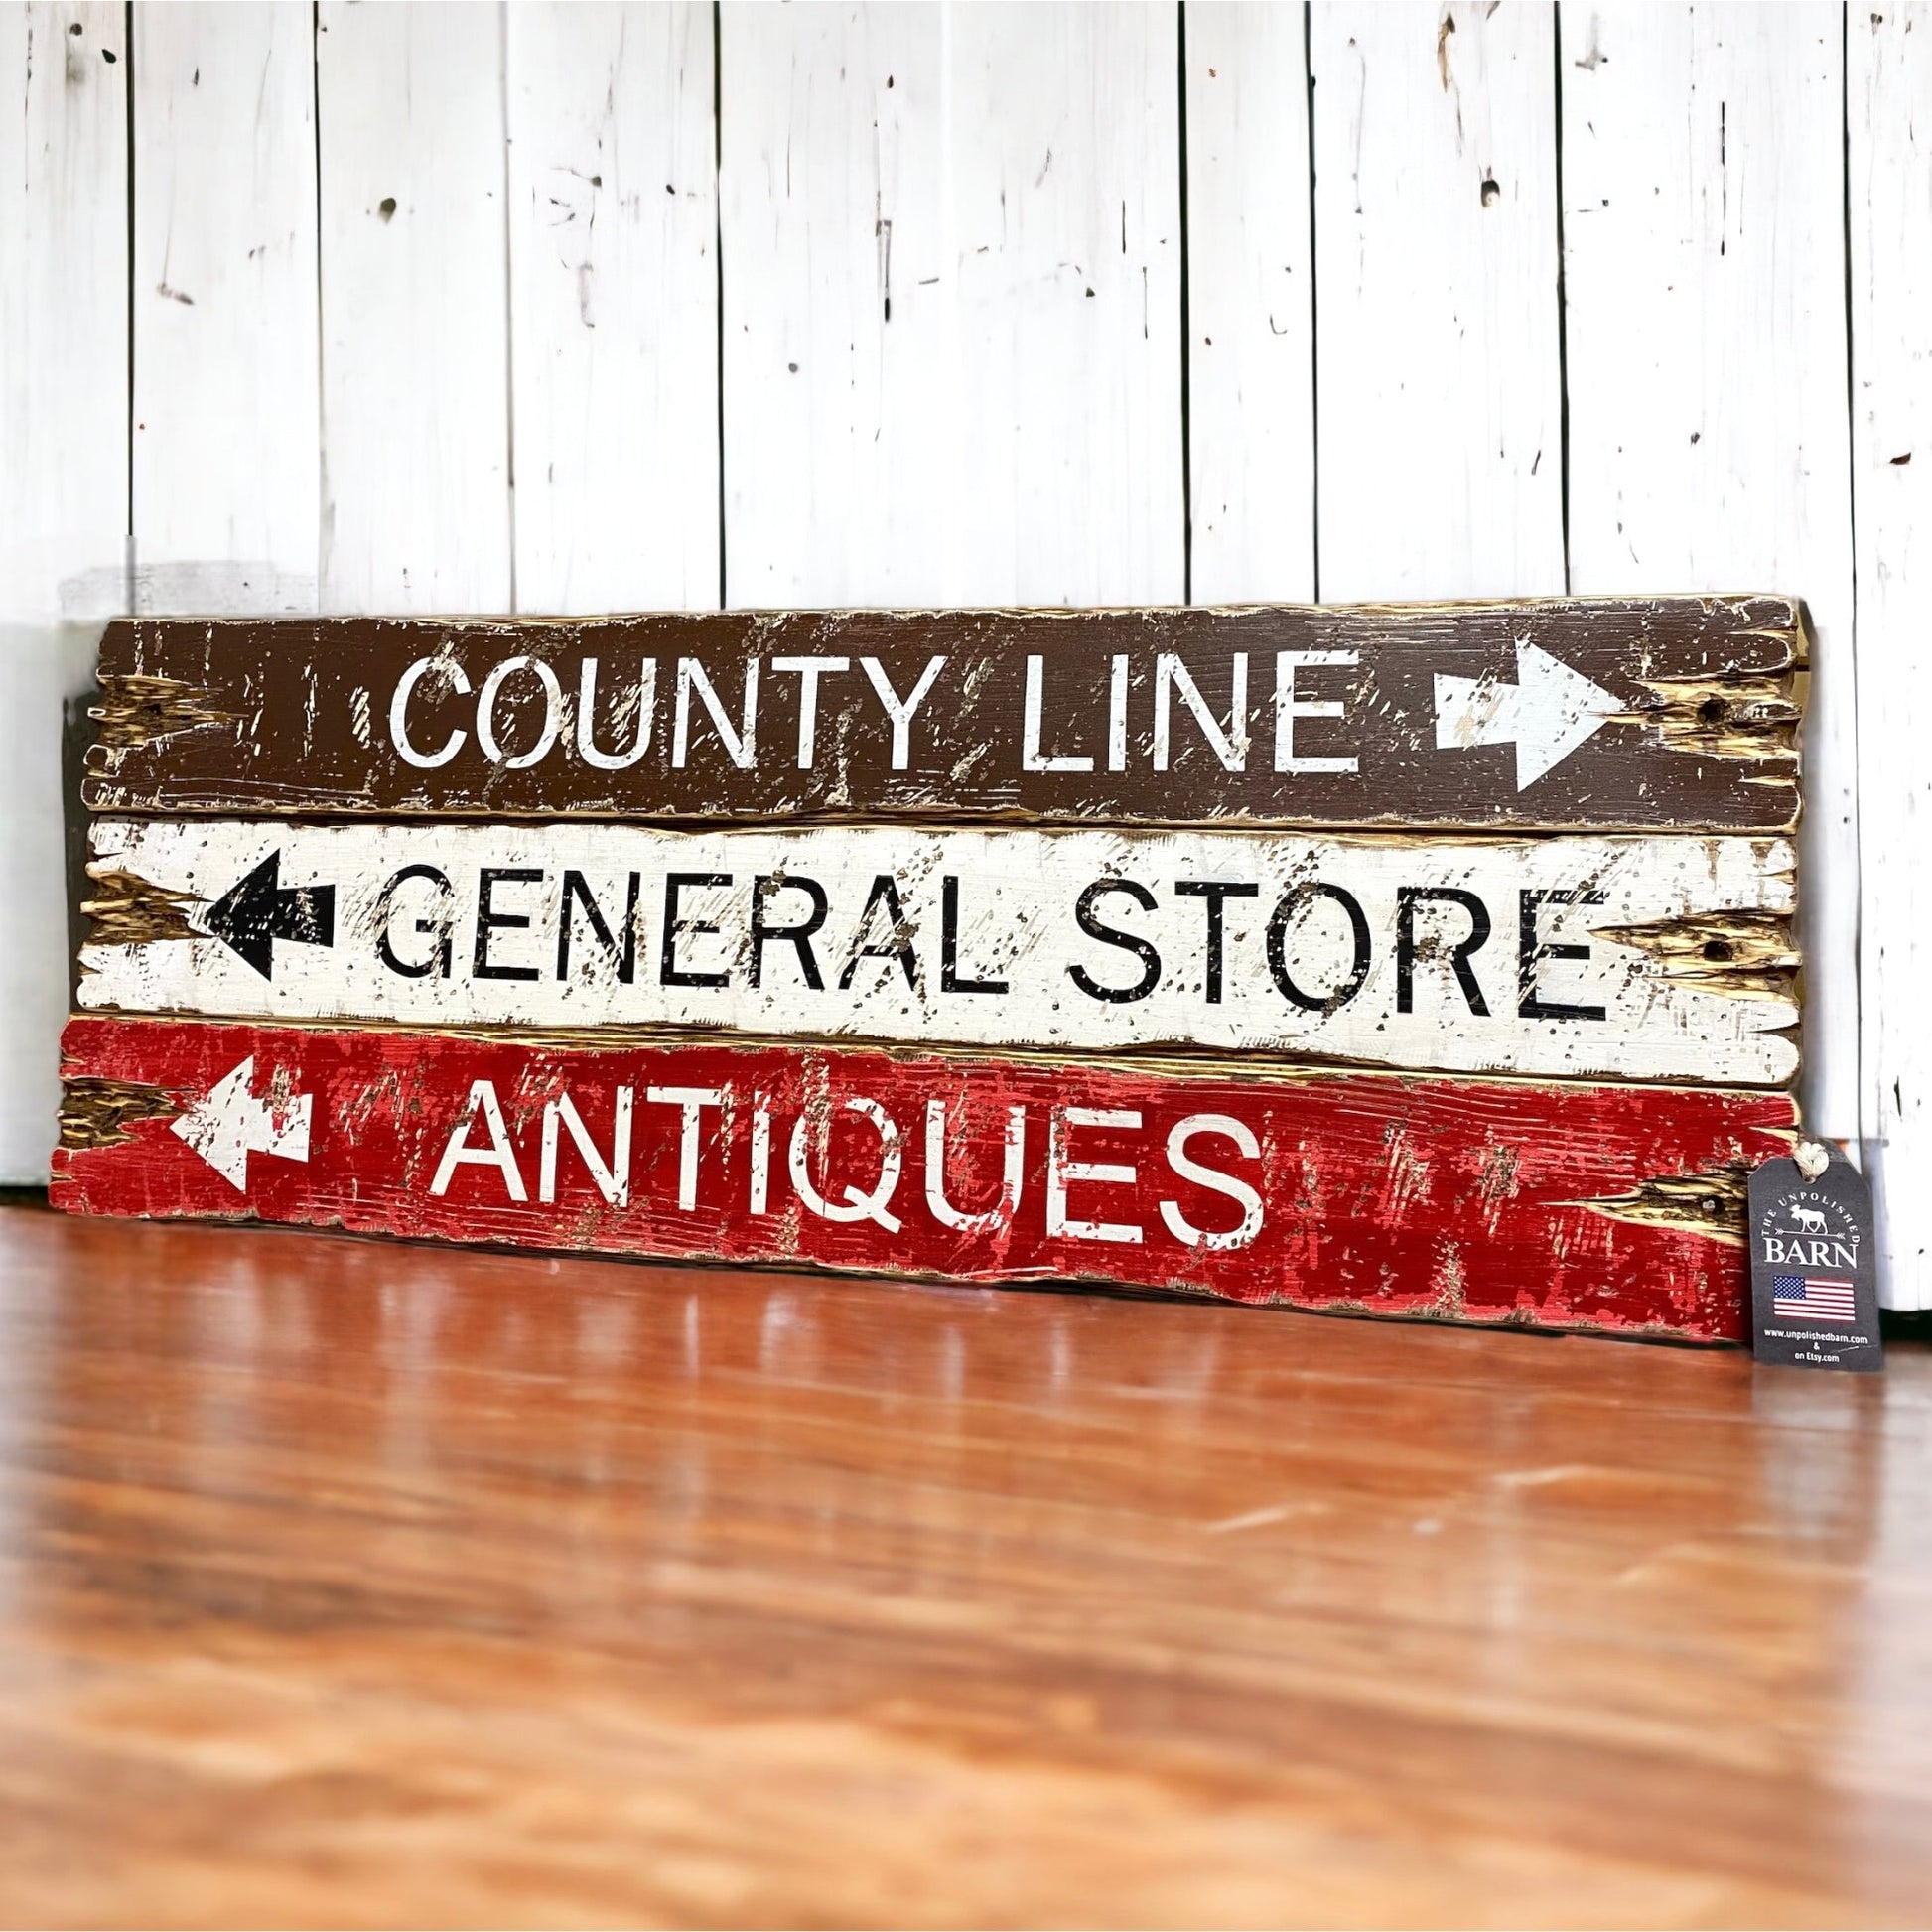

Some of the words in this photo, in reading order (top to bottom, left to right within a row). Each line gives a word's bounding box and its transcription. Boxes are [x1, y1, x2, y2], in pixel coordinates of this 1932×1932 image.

[388, 654, 948, 771] COUNTY
[1022, 650, 1361, 773] LINE
[373, 863, 1009, 994] GENERAL
[1066, 877, 1607, 1022] STORE
[427, 1078, 1265, 1252] ANTIQUES
[1761, 1209, 1777, 1237] THE
[1778, 1191, 1862, 1245] UNPOLISHED
[1762, 1237, 1860, 1269] BARN
[1763, 1328, 1868, 1345] www.unpolishedbarn.com
[1806, 1352, 1840, 1363] Etsy.com
[1813, 1342, 1821, 1351] &
